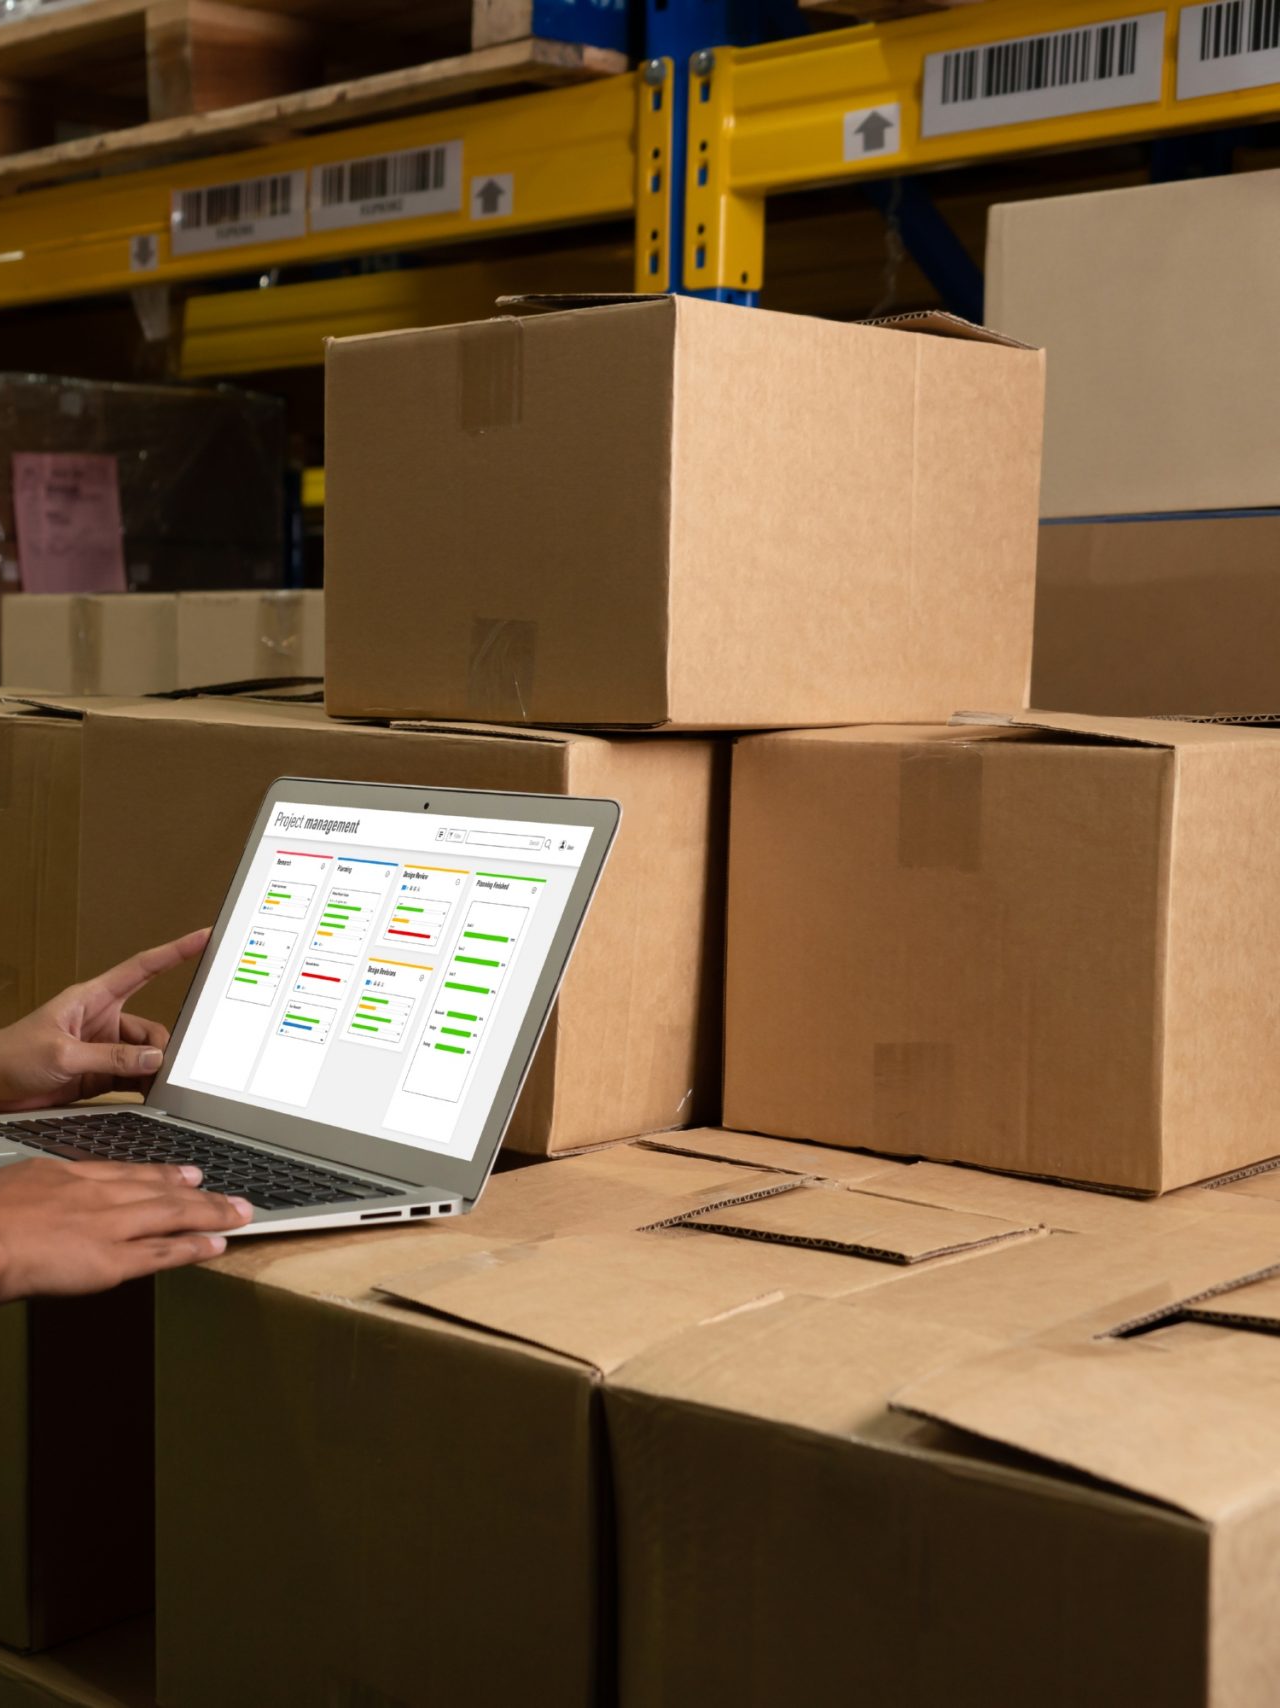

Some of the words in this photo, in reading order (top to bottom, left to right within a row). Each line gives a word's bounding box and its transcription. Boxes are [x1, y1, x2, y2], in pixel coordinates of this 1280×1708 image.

[274, 811, 305, 831] Project
[304, 817, 361, 835] management
[337, 865, 352, 874] Planning
[403, 870, 416, 880] Design
[416, 872, 429, 881] Review
[476, 879, 494, 890] Planning
[493, 881, 510, 891] Finished
[368, 965, 380, 975] Design
[379, 968, 397, 977] Revisions
